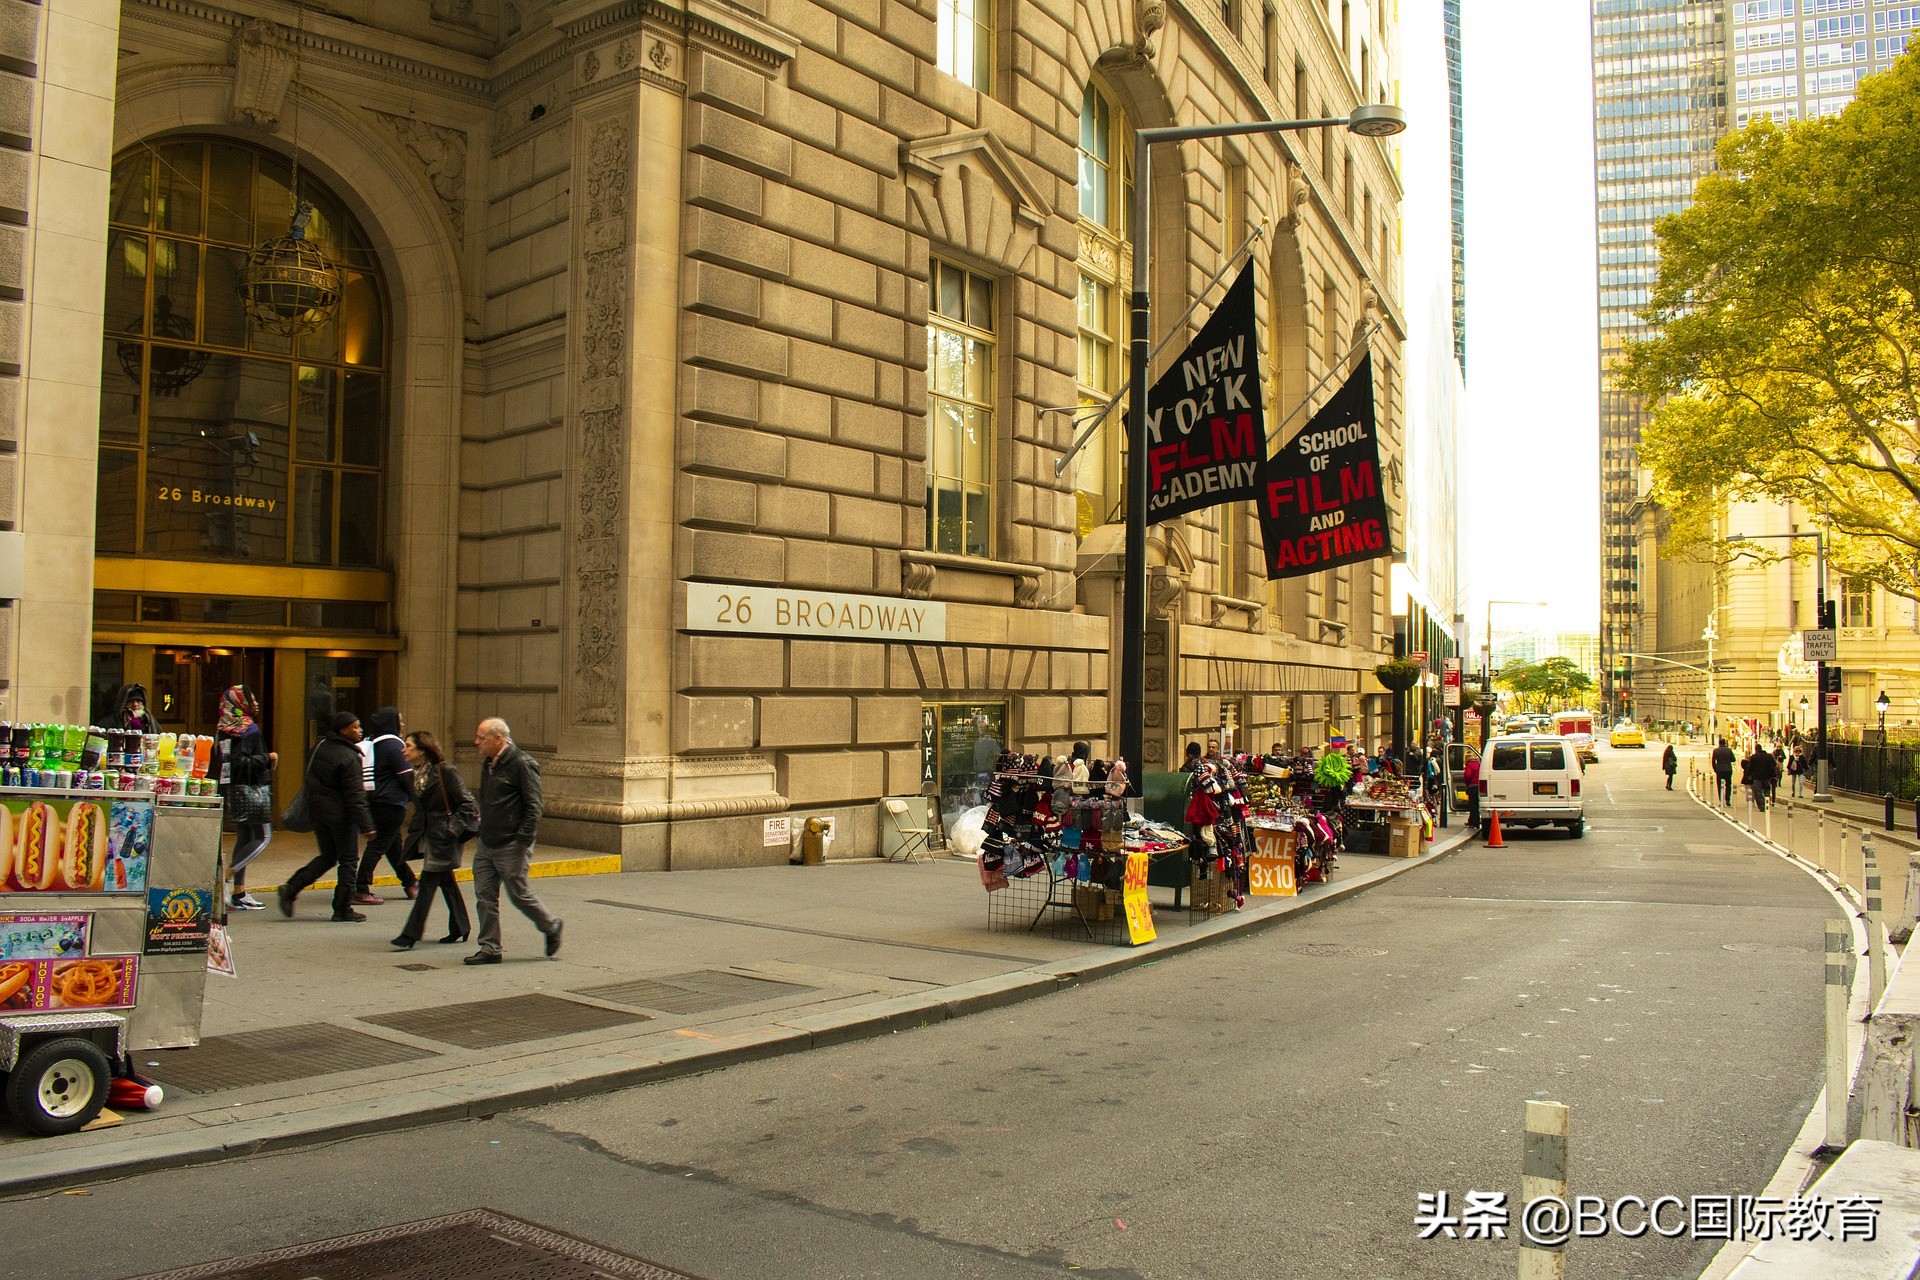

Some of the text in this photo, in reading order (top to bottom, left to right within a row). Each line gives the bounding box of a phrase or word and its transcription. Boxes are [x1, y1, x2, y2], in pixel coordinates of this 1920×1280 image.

[1182, 334, 1245, 392] NEW
[1149, 413, 1256, 492] FLM
[1299, 420, 1368, 455] SCHOOL
[1310, 454, 1330, 473] OF
[158, 487, 277, 512] 26 Broadway
[1266, 460, 1376, 519] FILM
[1309, 509, 1345, 532] AND
[1277, 518, 1383, 569] ACTING
[717, 594, 926, 633] 26 BROADWAY
[925, 712, 933, 779] NYFA
[769, 819, 786, 831] FIRE
[1252, 836, 1295, 860] SALE
[1126, 857, 1148, 890] SALE
[35, 961, 48, 1007] HOT DOG
[122, 958, 133, 1004] PRETZEL
